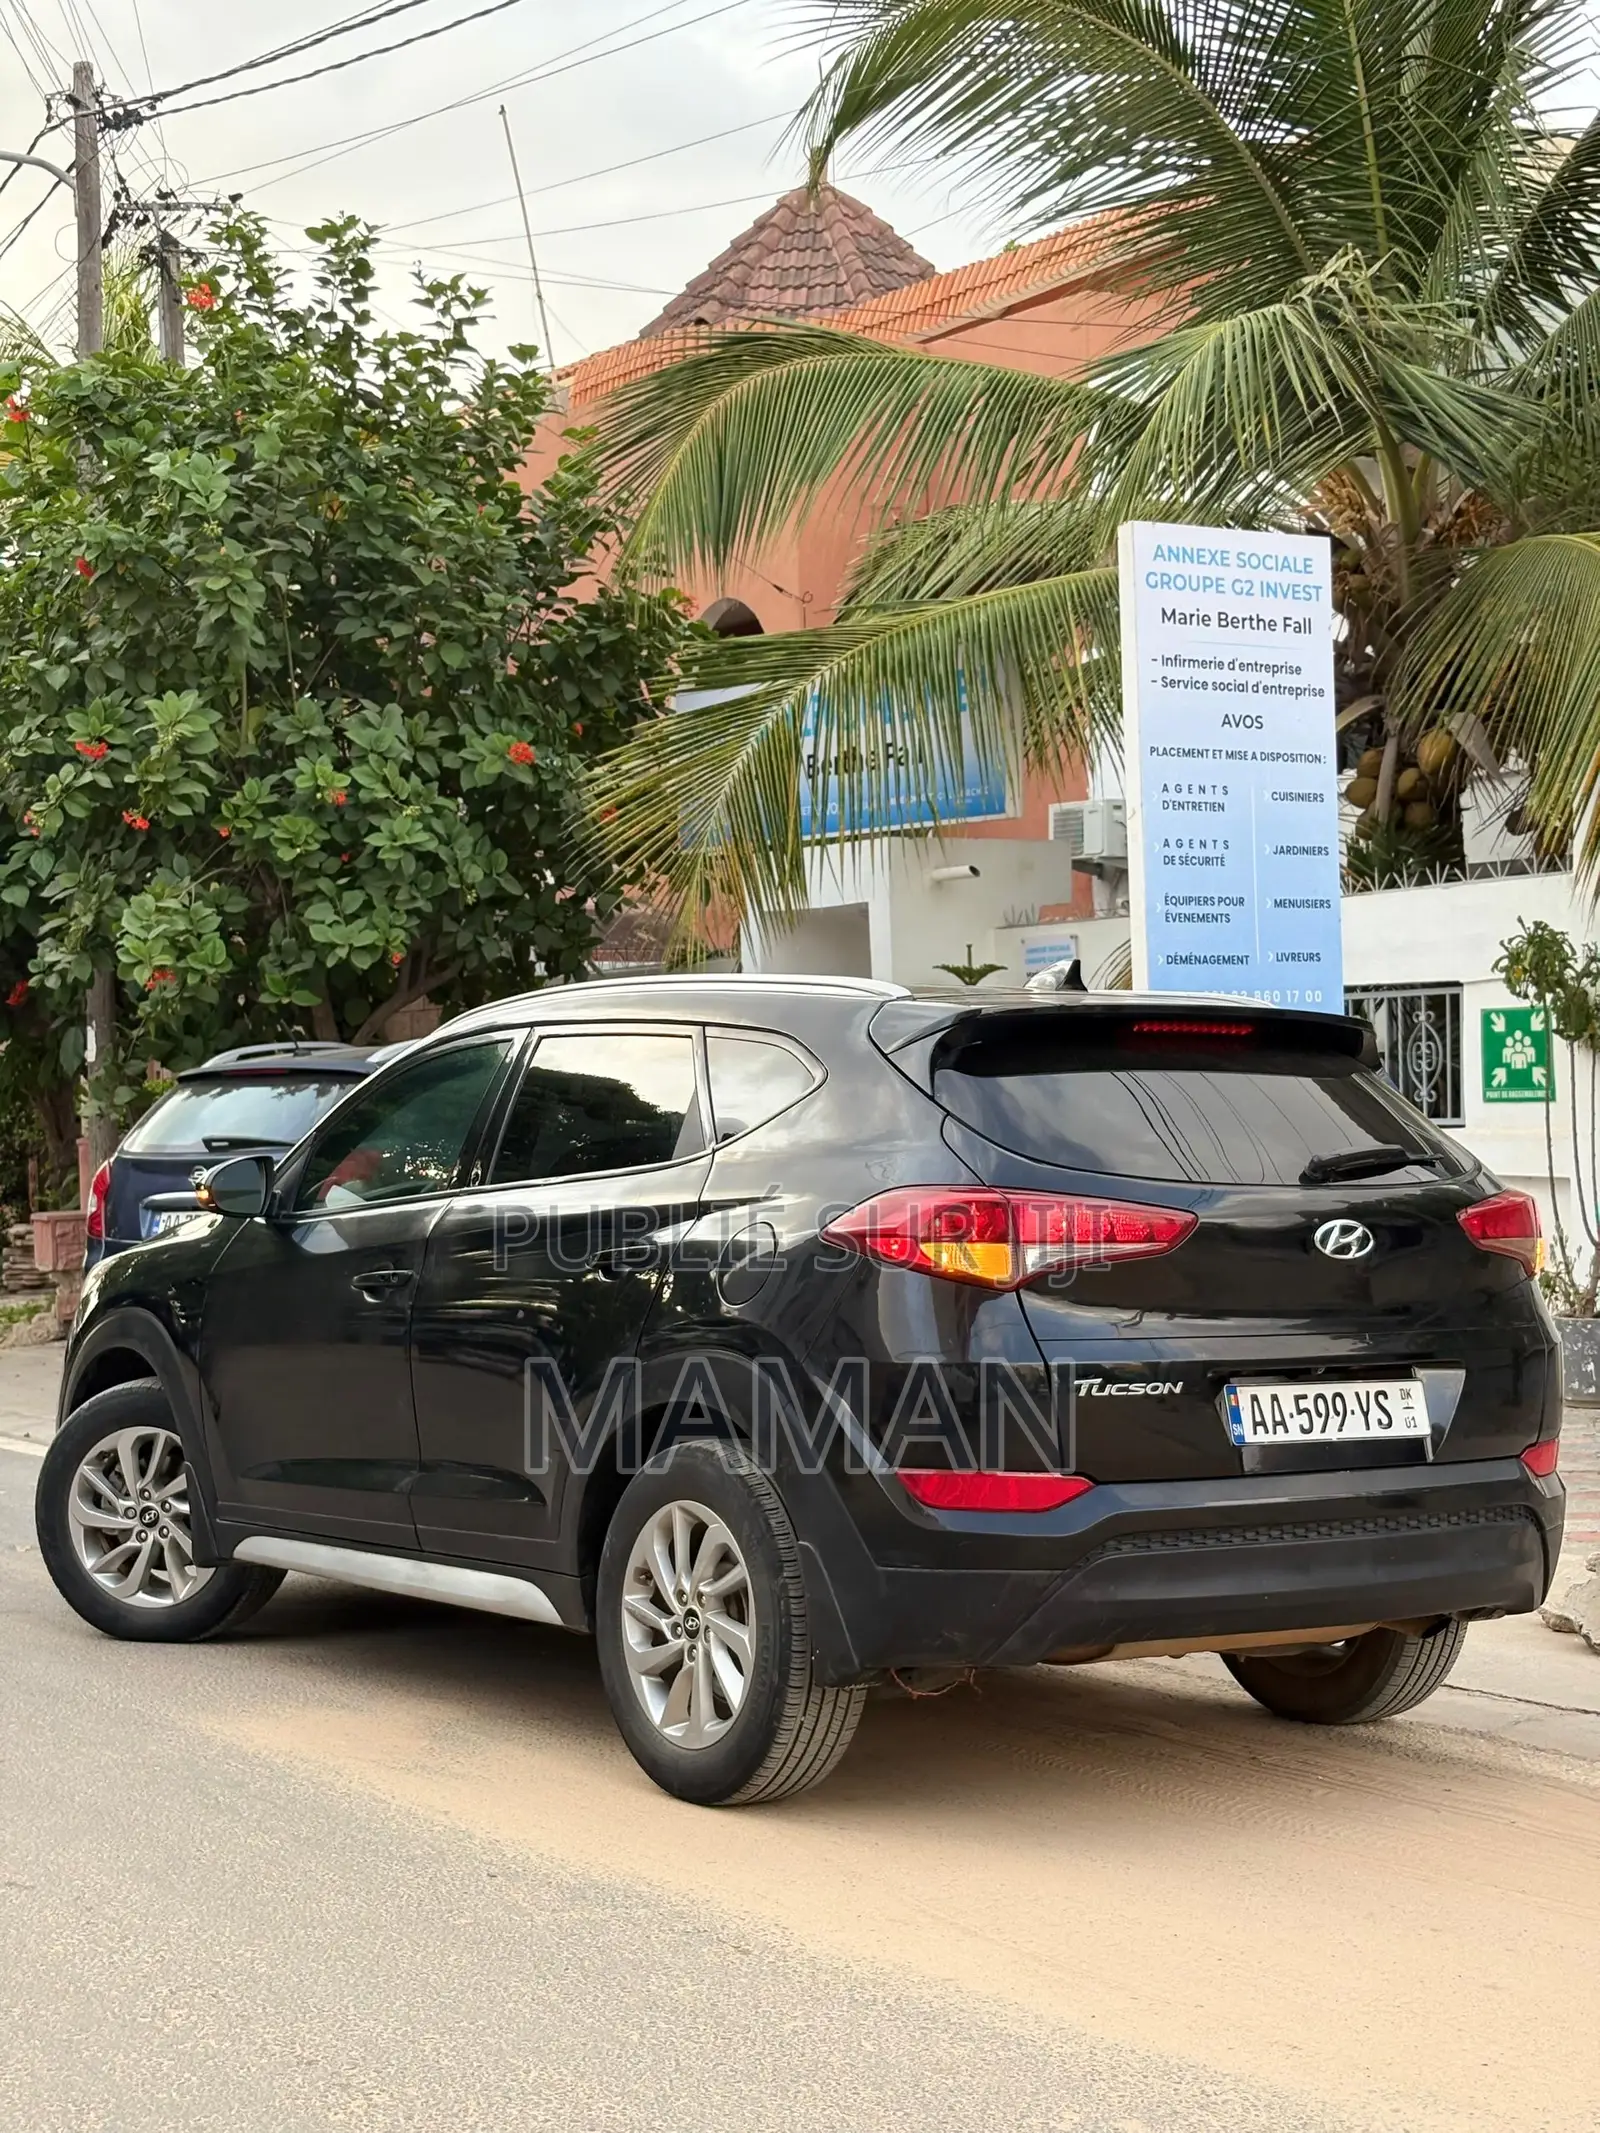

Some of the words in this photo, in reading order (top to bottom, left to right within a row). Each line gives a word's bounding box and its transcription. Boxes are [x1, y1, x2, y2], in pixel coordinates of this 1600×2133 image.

[1153, 544, 1231, 567] ANNEXE
[1236, 551, 1313, 574] SOCIALE
[1145, 571, 1225, 594] GROUPE
[1231, 578, 1255, 597] G2
[1260, 580, 1323, 602] INVEST
[1161, 608, 1211, 627] Marie
[1217, 611, 1277, 632] Berthe
[1283, 616, 1312, 635] Fall
[1161, 654, 1225, 670] Infirmerie
[1227, 658, 1302, 678] d'entreprise
[1160, 676, 1209, 691] Service
[1211, 679, 1249, 693] social
[1251, 681, 1325, 700] d'entreprise
[1221, 713, 1263, 730] AVOS
[1149, 746, 1210, 760] PLACEMENT
[1211, 748, 1224, 760] ET
[1225, 749, 1249, 761] MISE
[1250, 750, 1258, 761] A
[1259, 751, 1322, 765] DISPOSITION
[1161, 783, 1229, 796] AGENTS
[1271, 791, 1325, 803] CUISINIERS
[1162, 800, 1225, 813] D'ENTRETIEN
[1162, 838, 1229, 850] AGENTS
[1272, 845, 1329, 857] JARDINIERS
[1163, 855, 1177, 866] DE
[1178, 853, 1226, 867] SÉCURITÉ
[1164, 893, 1216, 908] ÉQUIPIERS
[1217, 896, 1245, 907] POUR
[1273, 898, 1331, 909] MENUISIERS
[1164, 910, 1231, 924] ÉVENEMENTS
[1166, 952, 1250, 966] DÉMÉNAGEMENT
[1275, 951, 1321, 963] LIVREURS
[1254, 990, 1280, 1003] 860
[1286, 990, 1299, 1003] 17
[1305, 990, 1322, 1003] 00
[1399, 1387, 1413, 1400] DK
[1232, 1423, 1243, 1436] SN
